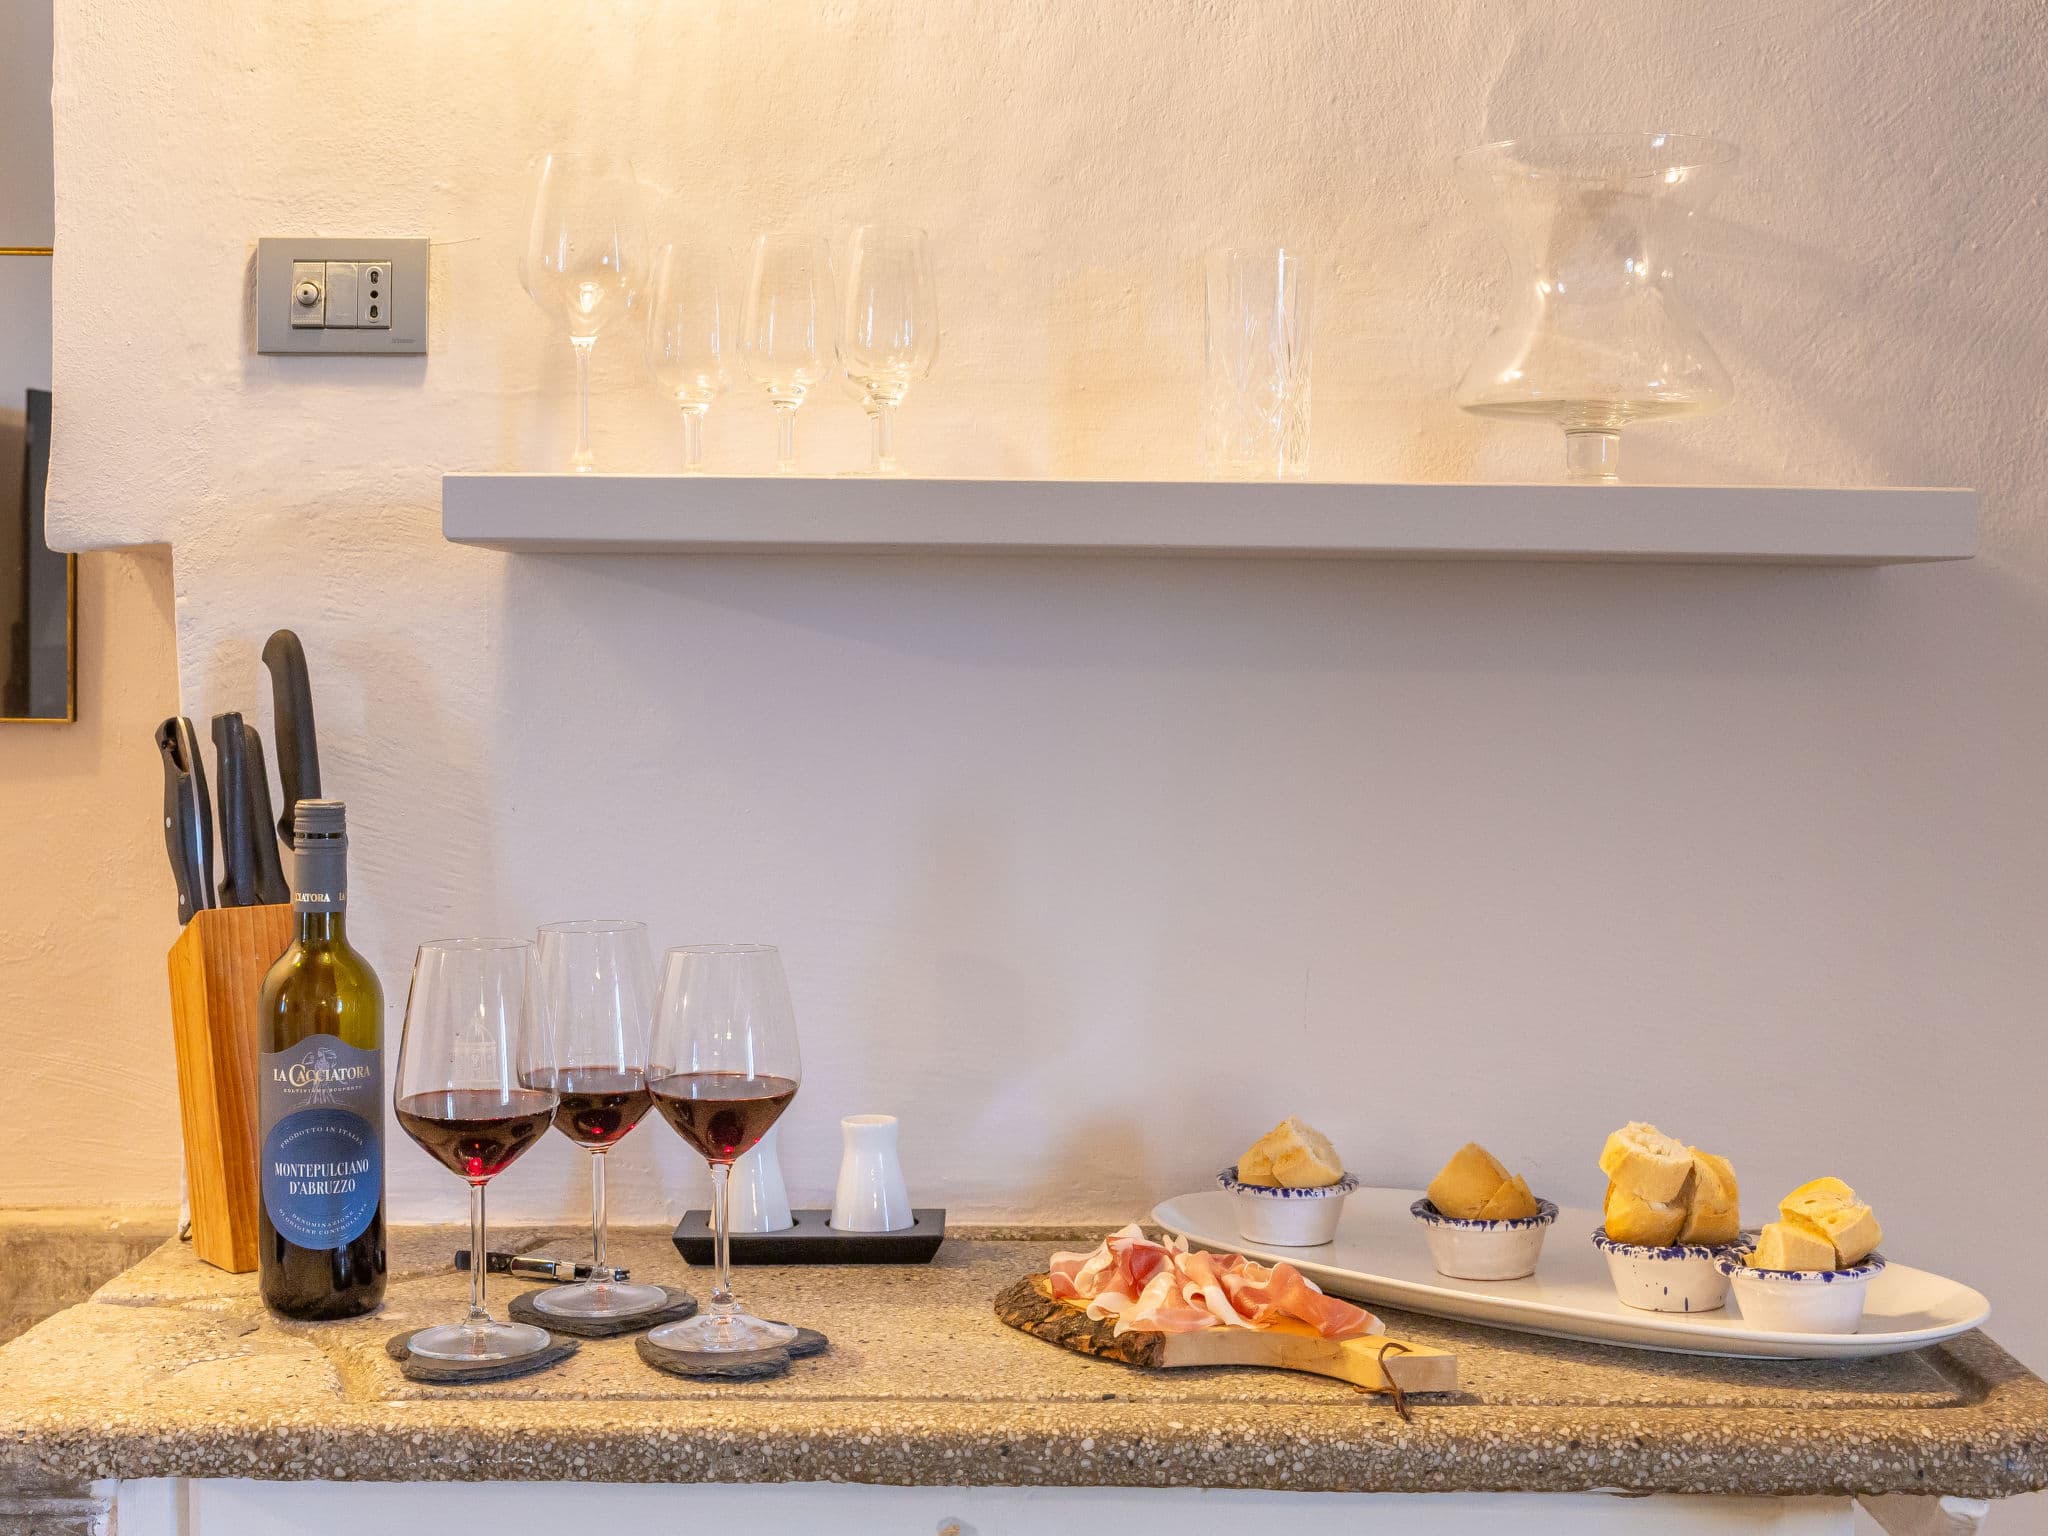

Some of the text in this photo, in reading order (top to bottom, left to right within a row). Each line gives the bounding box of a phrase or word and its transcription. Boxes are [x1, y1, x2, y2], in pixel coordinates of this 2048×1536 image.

[273, 1064, 371, 1087] LA CACCIATORA
[280, 1127, 323, 1149] PRODOTTO
[338, 1128, 363, 1146] ITALIA
[274, 1158, 369, 1178] MONTEPULCIANO
[289, 1178, 356, 1195] D'ABRUZZO
[292, 1211, 354, 1228] DENOMINAZIONE
